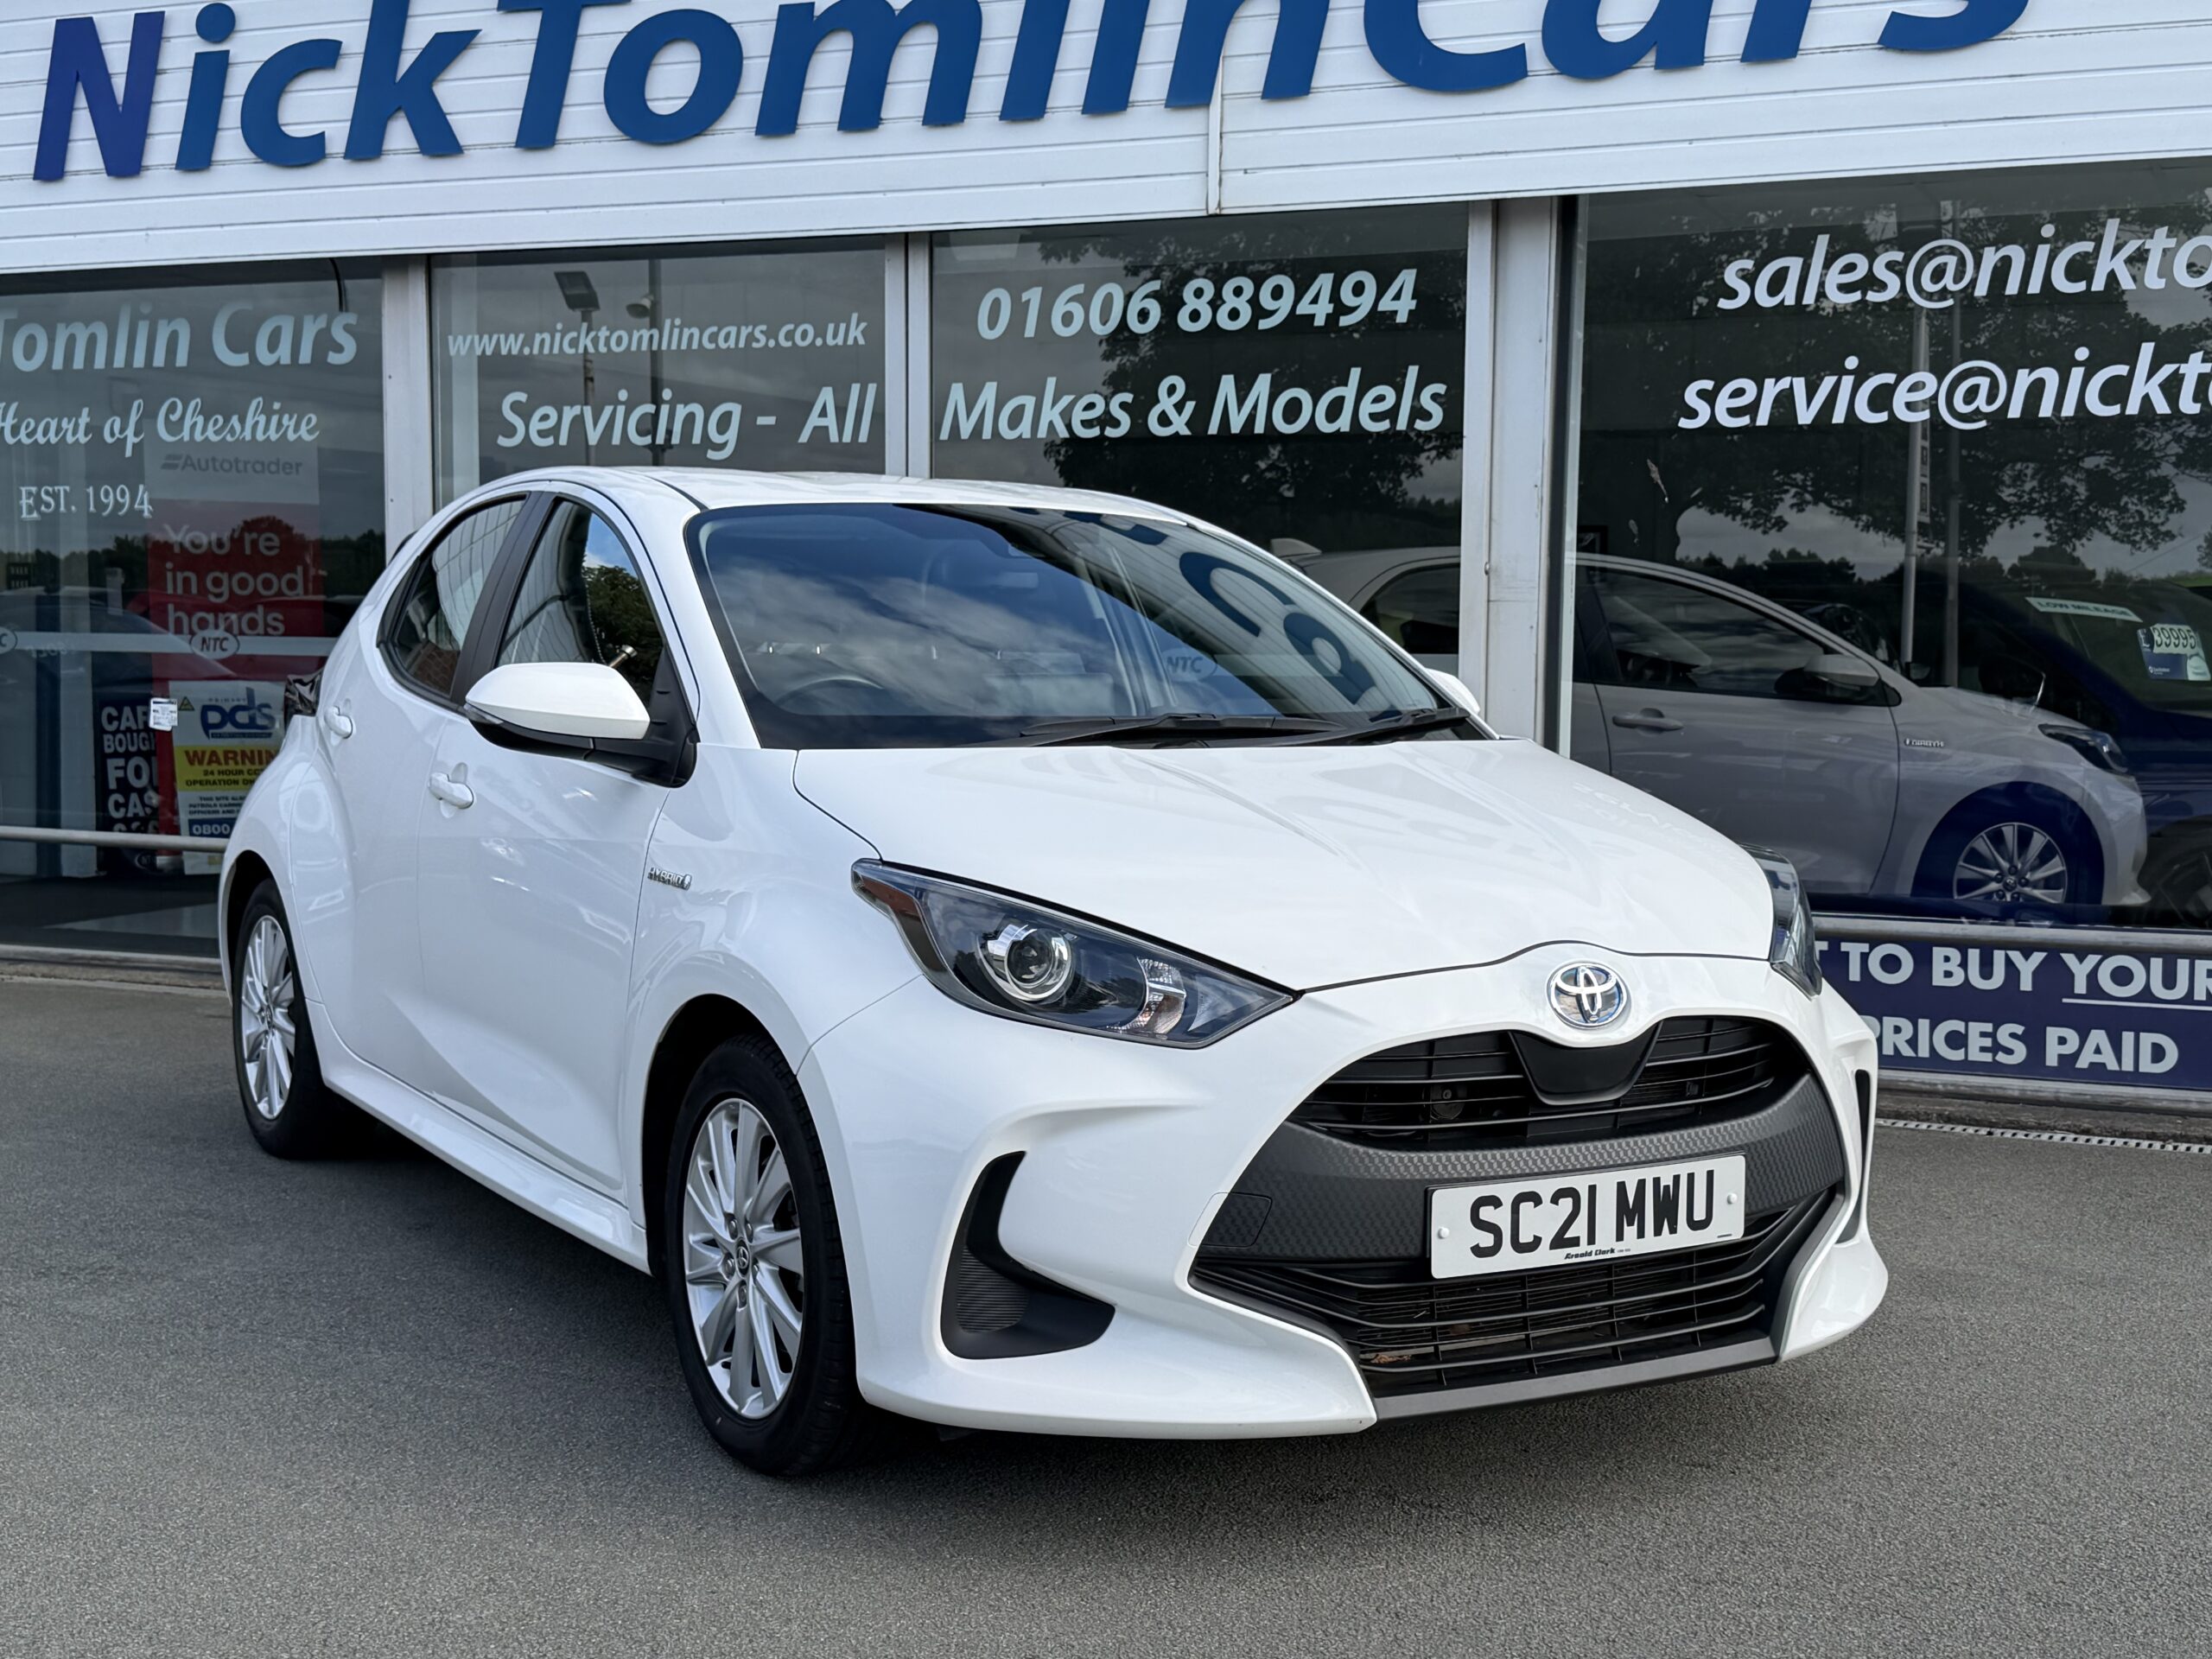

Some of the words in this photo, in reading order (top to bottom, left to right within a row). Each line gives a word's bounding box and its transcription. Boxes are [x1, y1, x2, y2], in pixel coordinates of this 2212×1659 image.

[976, 280, 1162, 340] 01606
[1176, 269, 1418, 333] 889494
[212, 300, 359, 367] Cars
[447, 312, 868, 356] www.nicktomlincars.co.uk
[1676, 341, 2212, 430] service@nickt
[103, 398, 145, 458] of
[156, 397, 321, 444] Cheshire
[497, 388, 743, 461] Servicing
[797, 383, 878, 444] All
[938, 376, 1135, 442] Makes
[1147, 374, 1197, 437] &
[1206, 365, 1448, 435] Models
[180, 454, 303, 477] Autotrader
[18, 486, 78, 521] EST.
[86, 483, 154, 518] 1994
[164, 561, 199, 595] in
[205, 564, 304, 604] good
[167, 603, 286, 637] hands
[200, 635, 229, 652] NTC
[192, 823, 231, 836] 0800
[1840, 941, 1915, 985] TO
[1931, 946, 2050, 992] BUY
[2045, 1027, 2179, 1074] PAID
[1469, 1183, 1598, 1259] SC21
[1615, 1168, 1715, 1243] MWU
